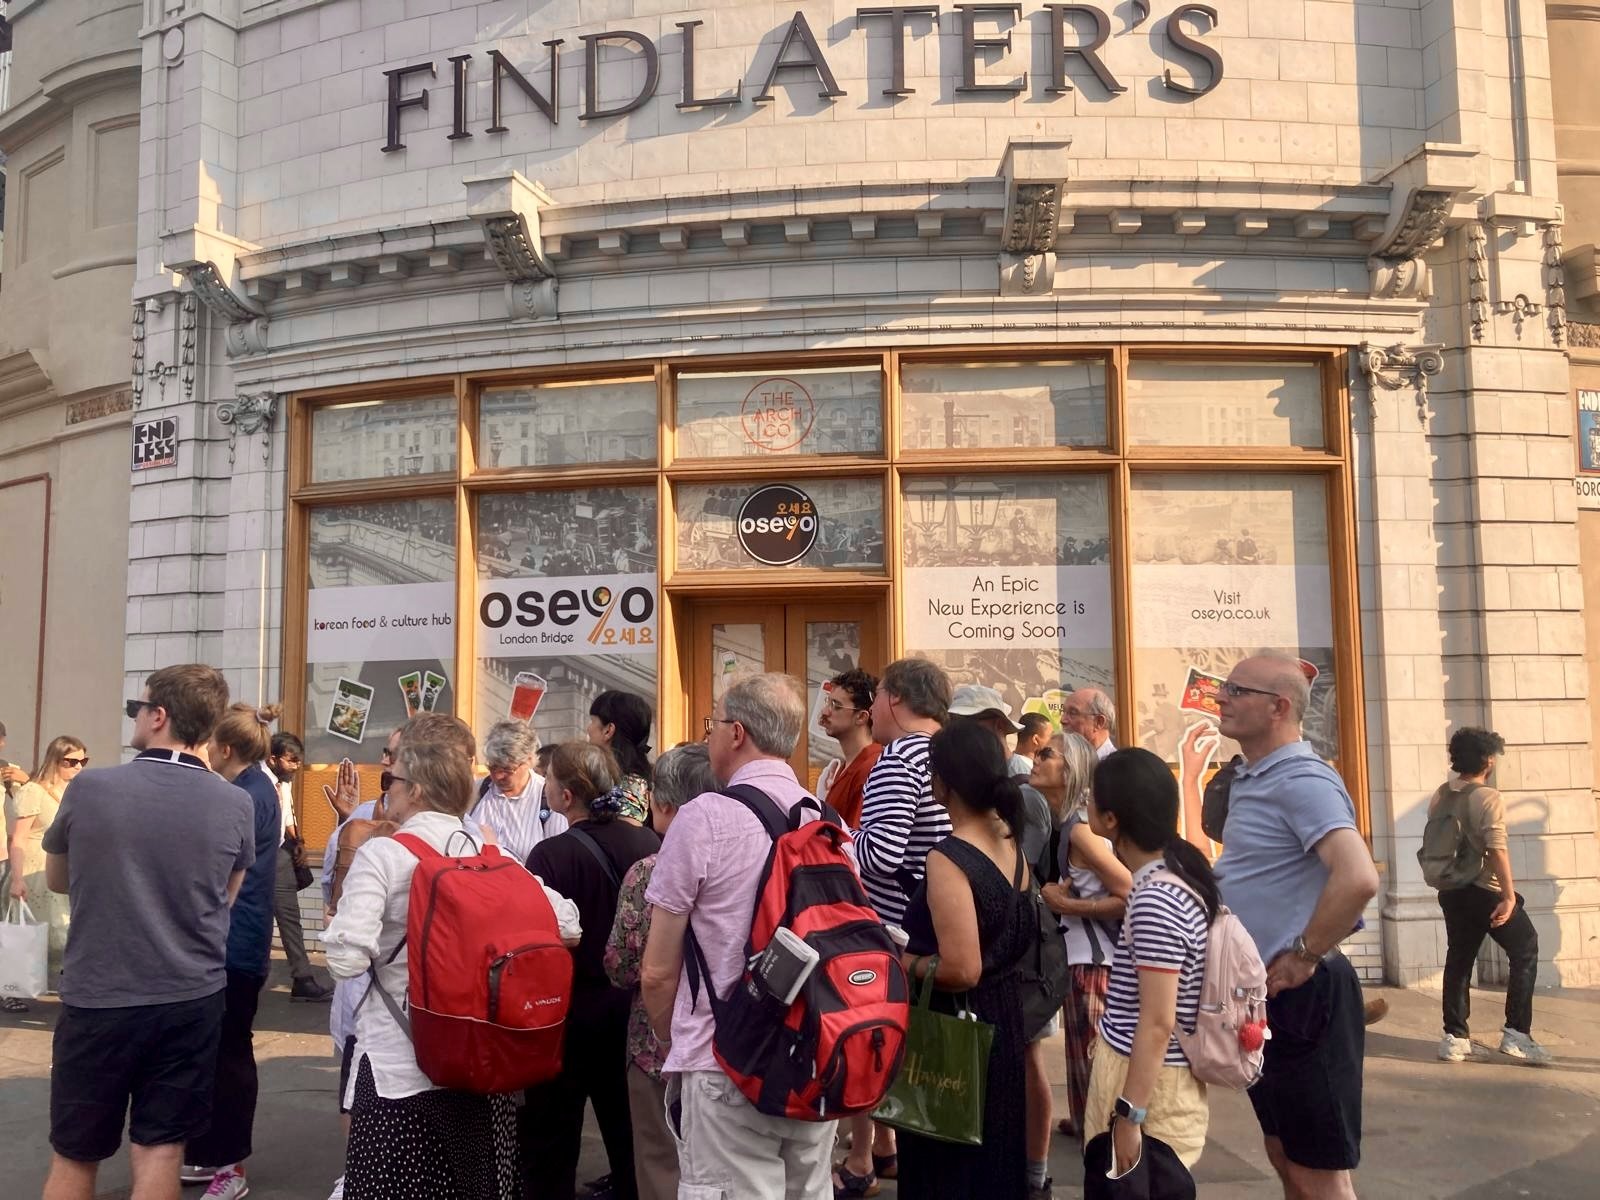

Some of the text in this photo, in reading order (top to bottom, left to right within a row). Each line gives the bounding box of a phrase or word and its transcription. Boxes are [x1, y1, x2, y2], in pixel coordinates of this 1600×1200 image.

[760, 391, 794, 406] THE
[754, 407, 801, 422] ARCH
[134, 420, 175, 444] END
[763, 424, 791, 438] CO
[134, 439, 175, 464] LESS
[776, 502, 812, 515] 오세요
[741, 516, 814, 541] oseyo
[972, 575, 1039, 597] An Epic
[1213, 589, 1241, 605] Visit
[480, 586, 654, 645] oseyo
[928, 598, 1085, 619] New Experience is
[1191, 607, 1270, 622] oseyo.co.uk
[314, 613, 451, 630] korean food & culture hub
[500, 632, 574, 645] London Bridge
[601, 627, 654, 645] 오세요
[948, 621, 1066, 641] Coming Soon
